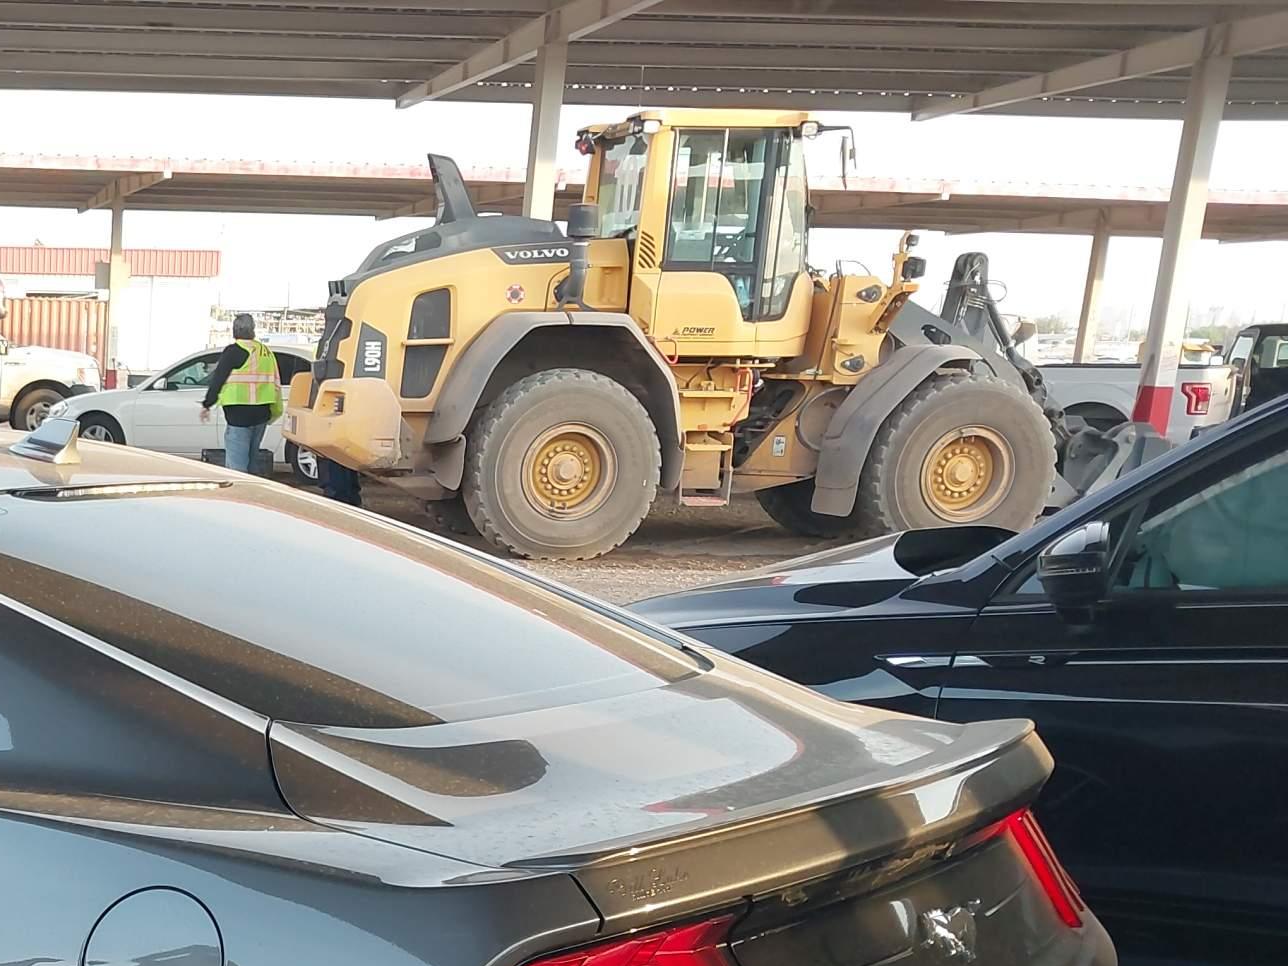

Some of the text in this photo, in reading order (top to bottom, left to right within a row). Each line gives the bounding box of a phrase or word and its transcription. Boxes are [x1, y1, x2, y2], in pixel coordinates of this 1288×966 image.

[504, 247, 569, 259] VOLVO
[682, 326, 715, 334] POWER
[364, 341, 382, 372] L90H
